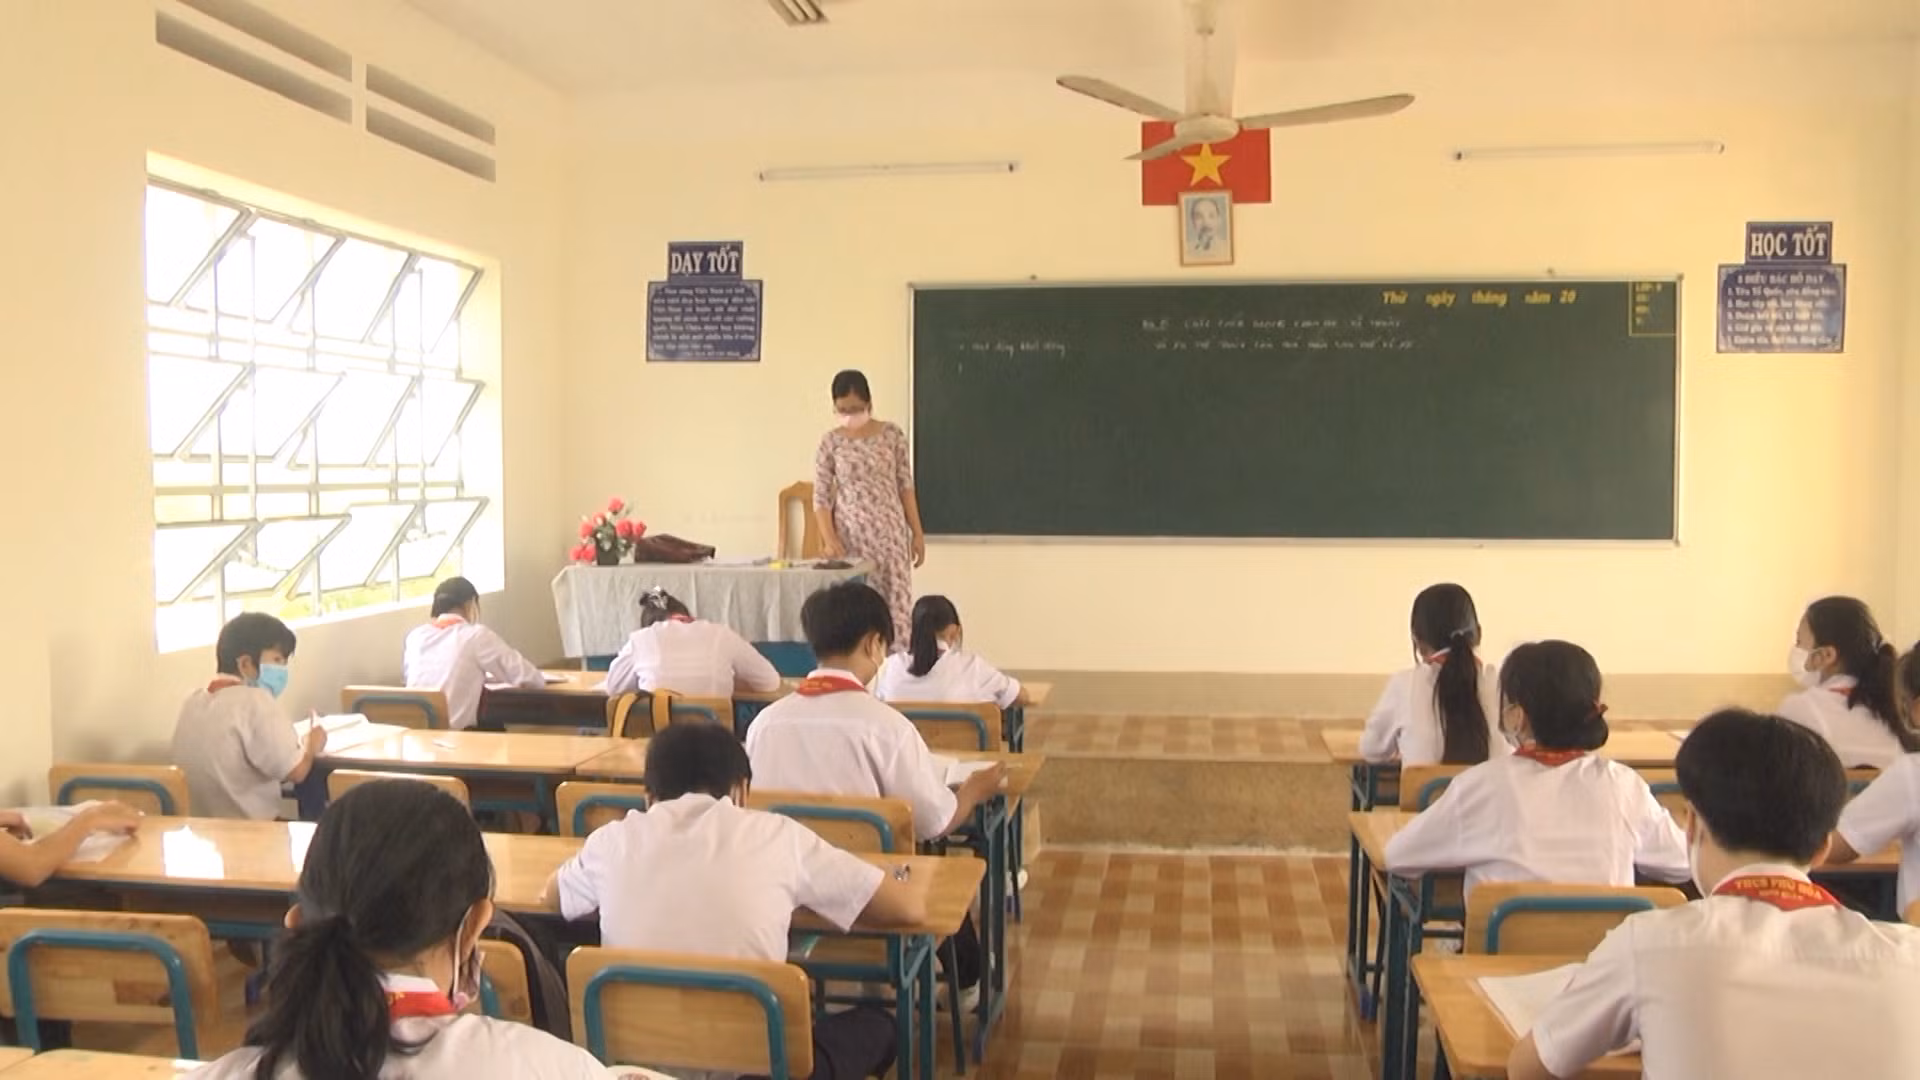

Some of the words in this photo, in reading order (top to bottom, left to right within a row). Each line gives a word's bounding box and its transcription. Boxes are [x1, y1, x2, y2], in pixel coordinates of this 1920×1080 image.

[1750, 232, 1788, 260] HỌC
[1791, 225, 1827, 256] TỐT
[671, 252, 704, 277] DẠY
[706, 243, 739, 273] TỐT
[1425, 290, 1456, 307] ngày
[1471, 290, 1508, 307] tháng
[1559, 290, 1577, 304] 20
